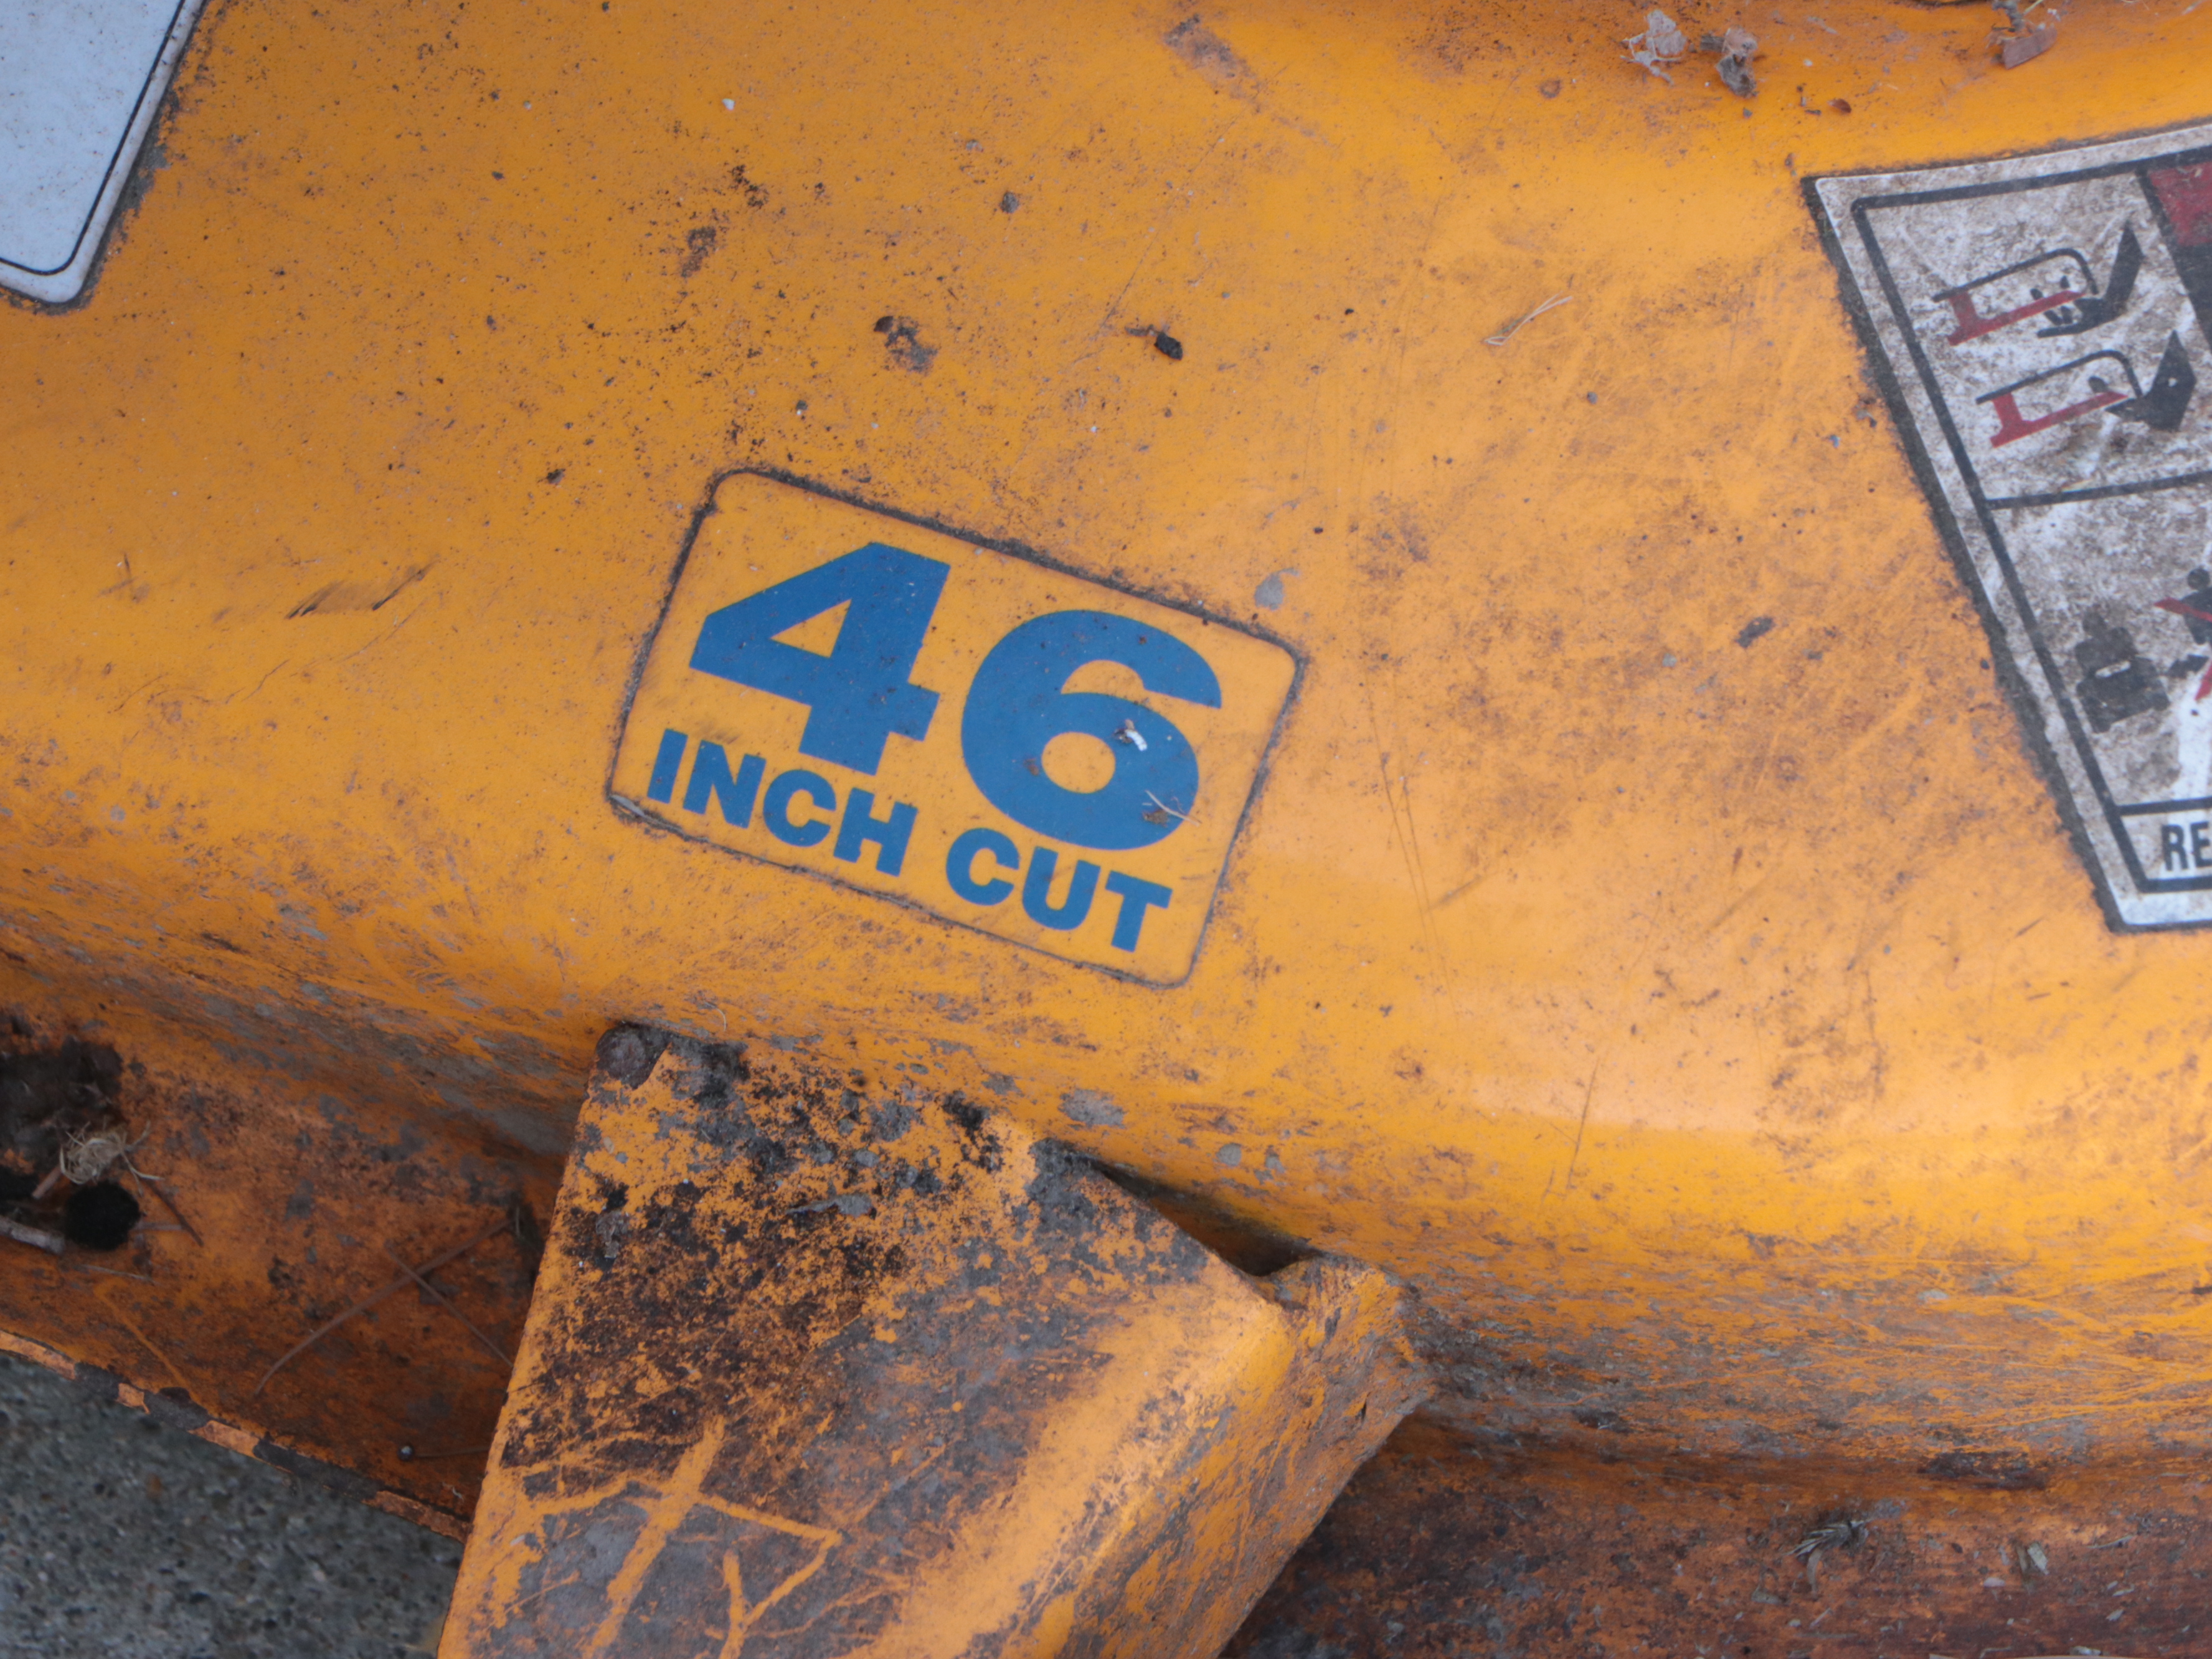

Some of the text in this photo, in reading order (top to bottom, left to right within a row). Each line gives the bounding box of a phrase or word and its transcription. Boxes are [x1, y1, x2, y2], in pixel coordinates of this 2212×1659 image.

[689, 542, 1222, 851] 46
[646, 729, 1172, 953] INCH CUT
[2161, 821, 2212, 871] RE
